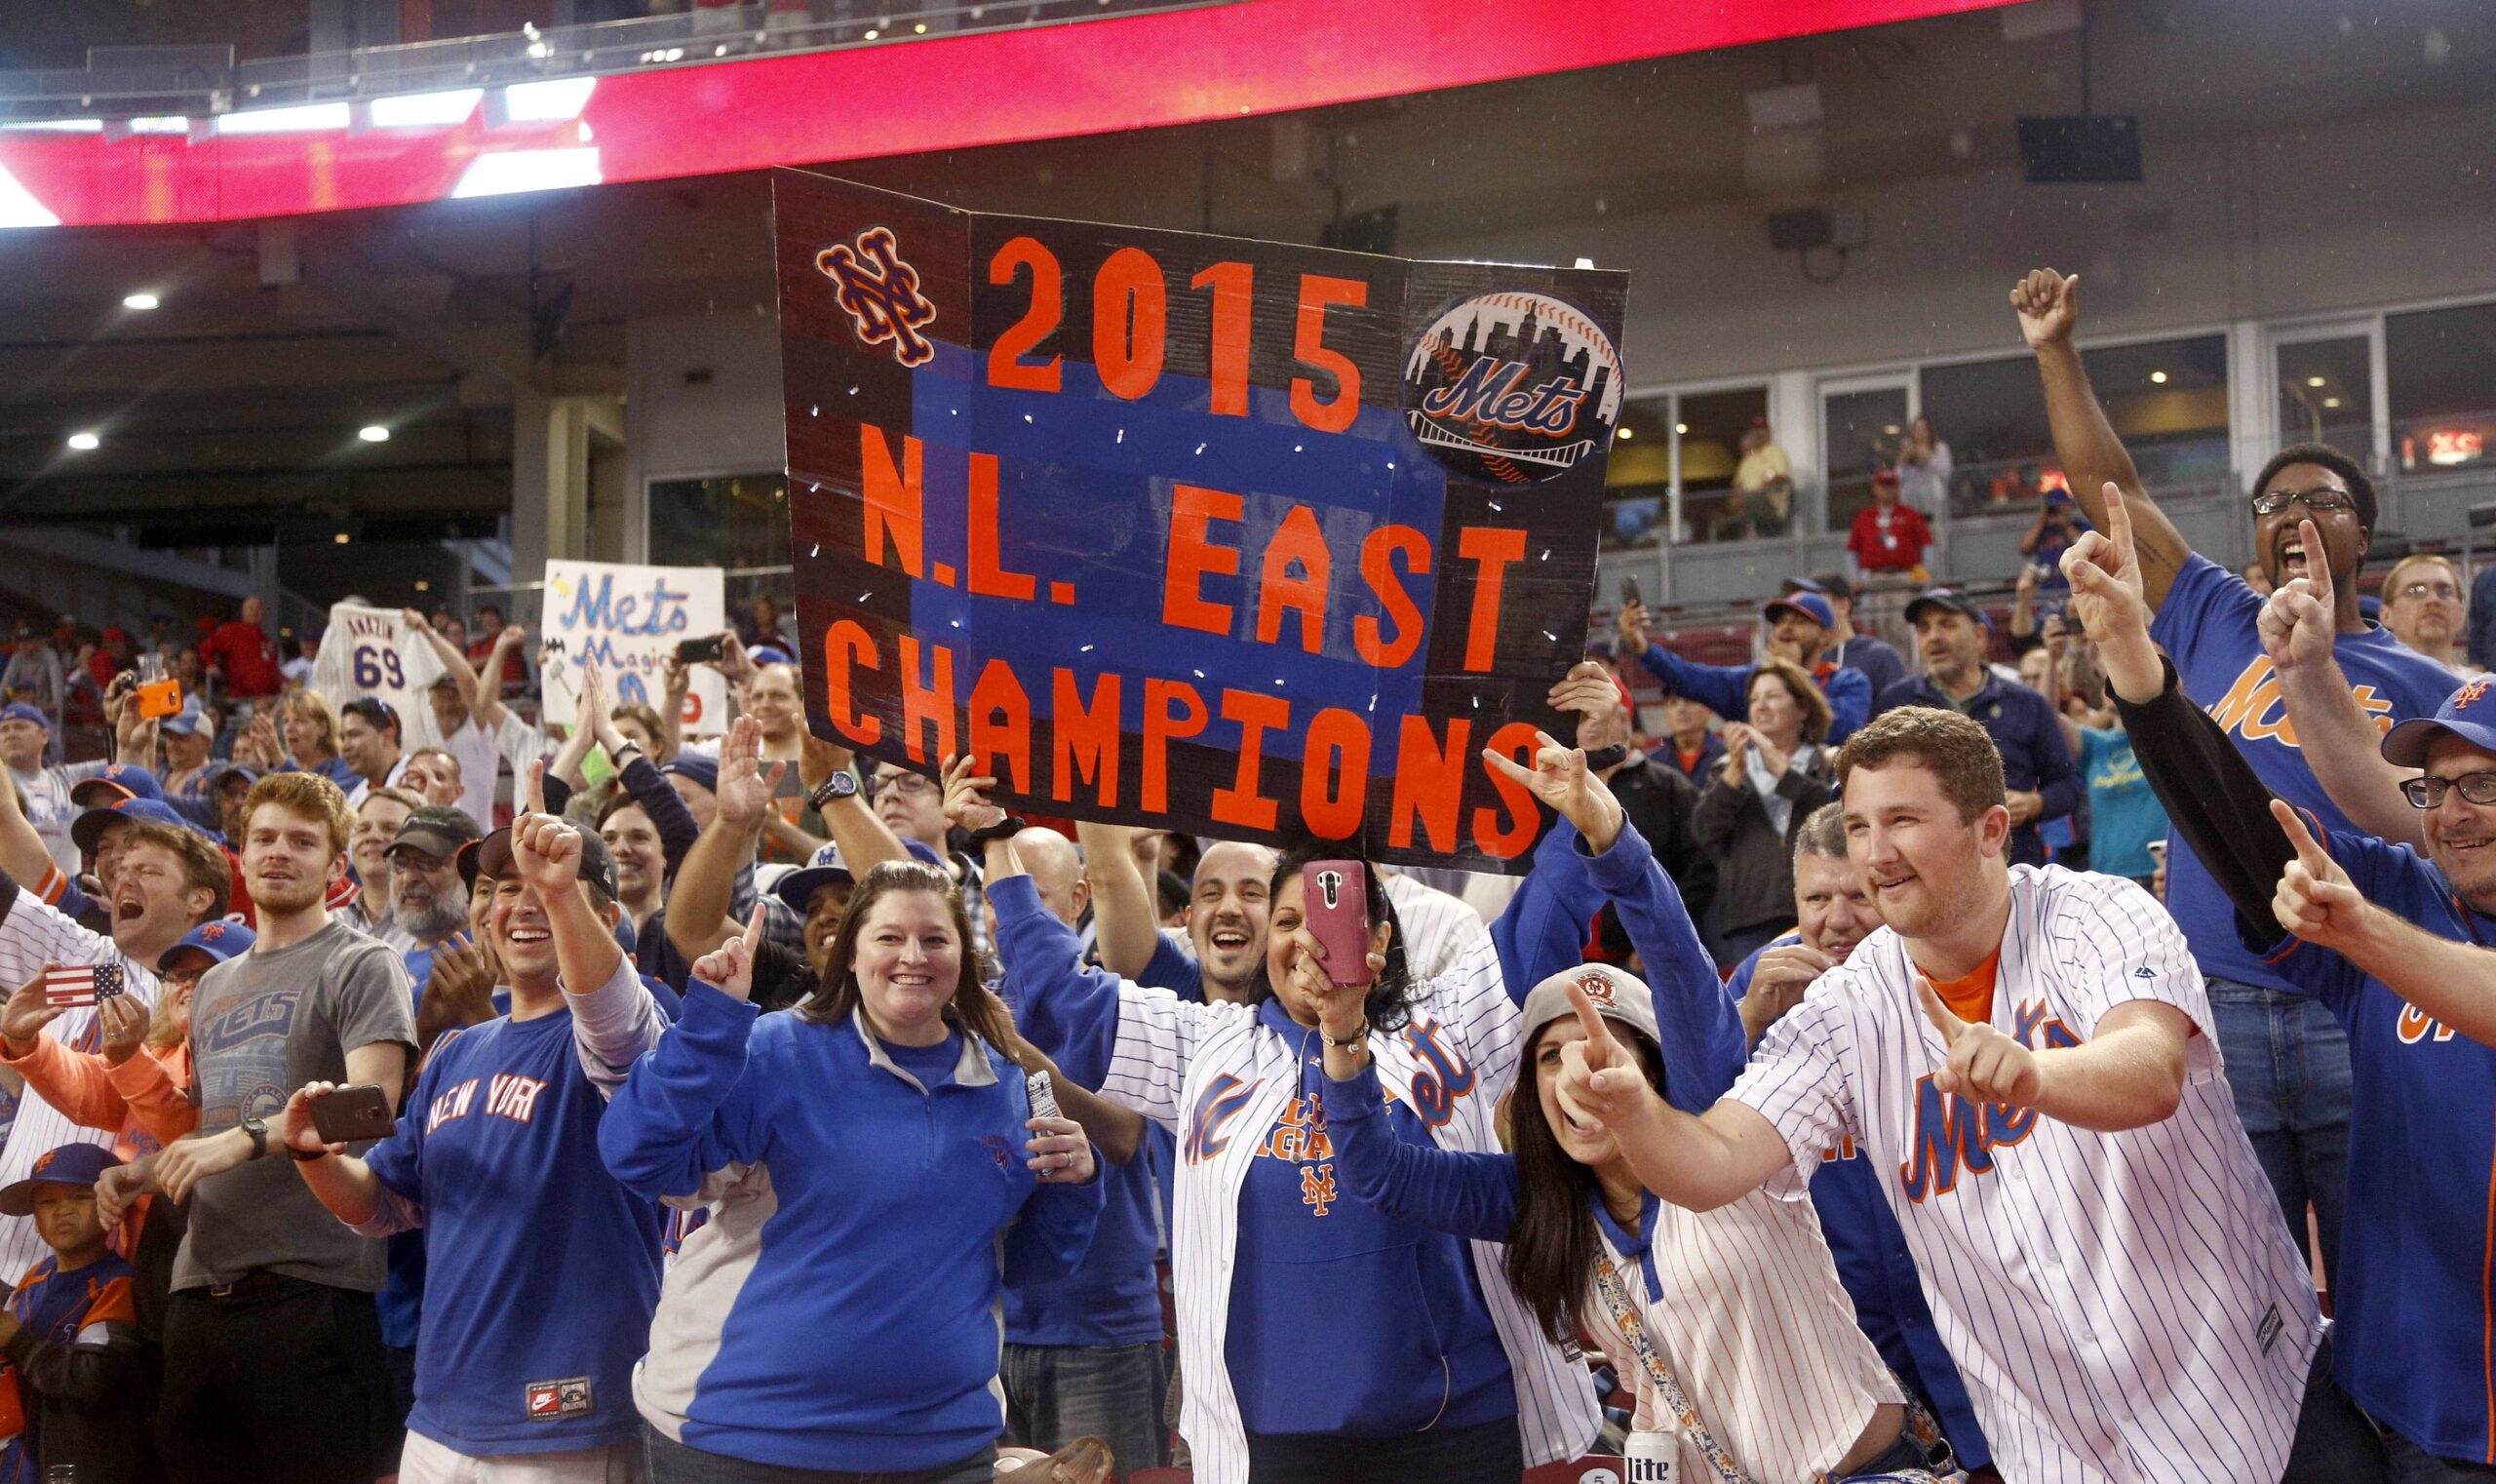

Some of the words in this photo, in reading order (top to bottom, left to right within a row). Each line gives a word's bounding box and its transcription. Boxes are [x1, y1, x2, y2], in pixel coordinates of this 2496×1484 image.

[987, 236, 1367, 433] 2015
[1423, 356, 1589, 438] Mets
[861, 423, 1075, 606] N.L.
[1162, 484, 1528, 675] EAST
[560, 571, 688, 637] Mets
[354, 644, 406, 690] 69
[824, 619, 1543, 862] CHAMPIONS
[199, 990, 301, 1054] METS
[258, 1087, 287, 1110] STADIU
[425, 1076, 482, 1137] NEW
[486, 1072, 549, 1124] YORK
